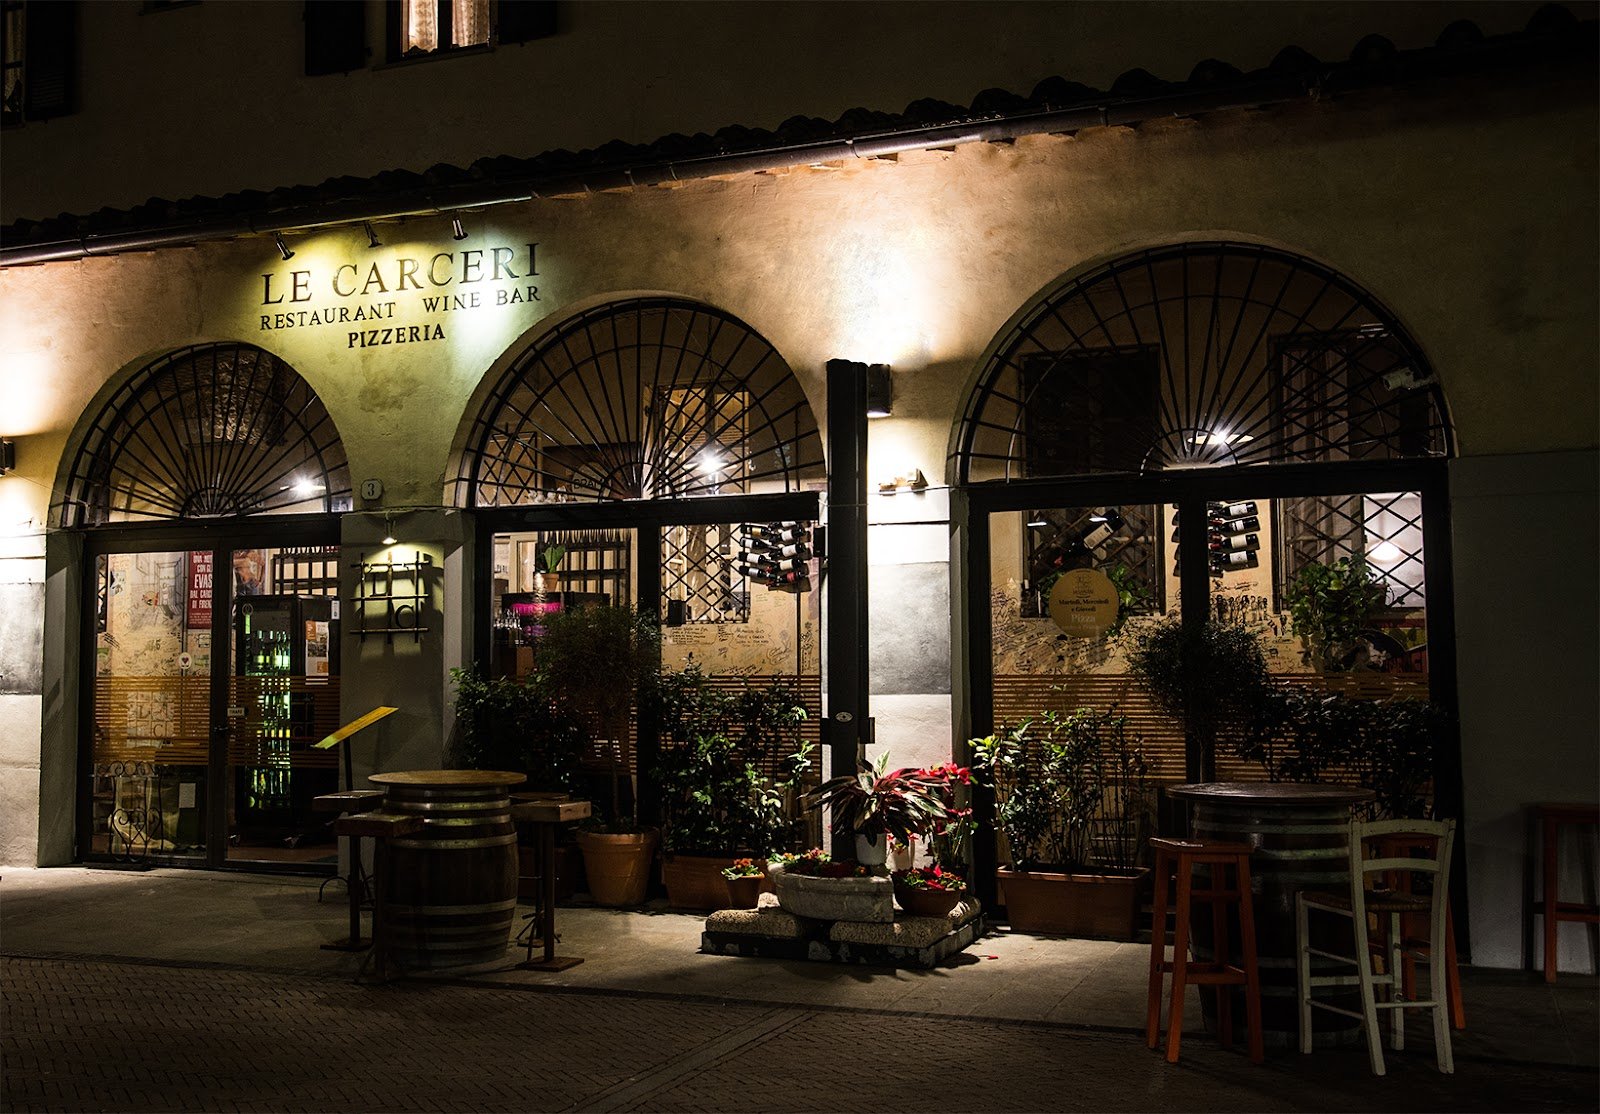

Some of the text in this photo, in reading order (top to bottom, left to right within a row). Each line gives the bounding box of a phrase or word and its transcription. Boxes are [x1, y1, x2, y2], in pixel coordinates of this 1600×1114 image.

[261, 242, 541, 306] LE CARCERI
[259, 285, 541, 331] RESTAURANT WINE BAR
[347, 323, 446, 349] PIZZERIA
[367, 482, 375, 497] 3
[194, 573, 213, 589] EVAS
